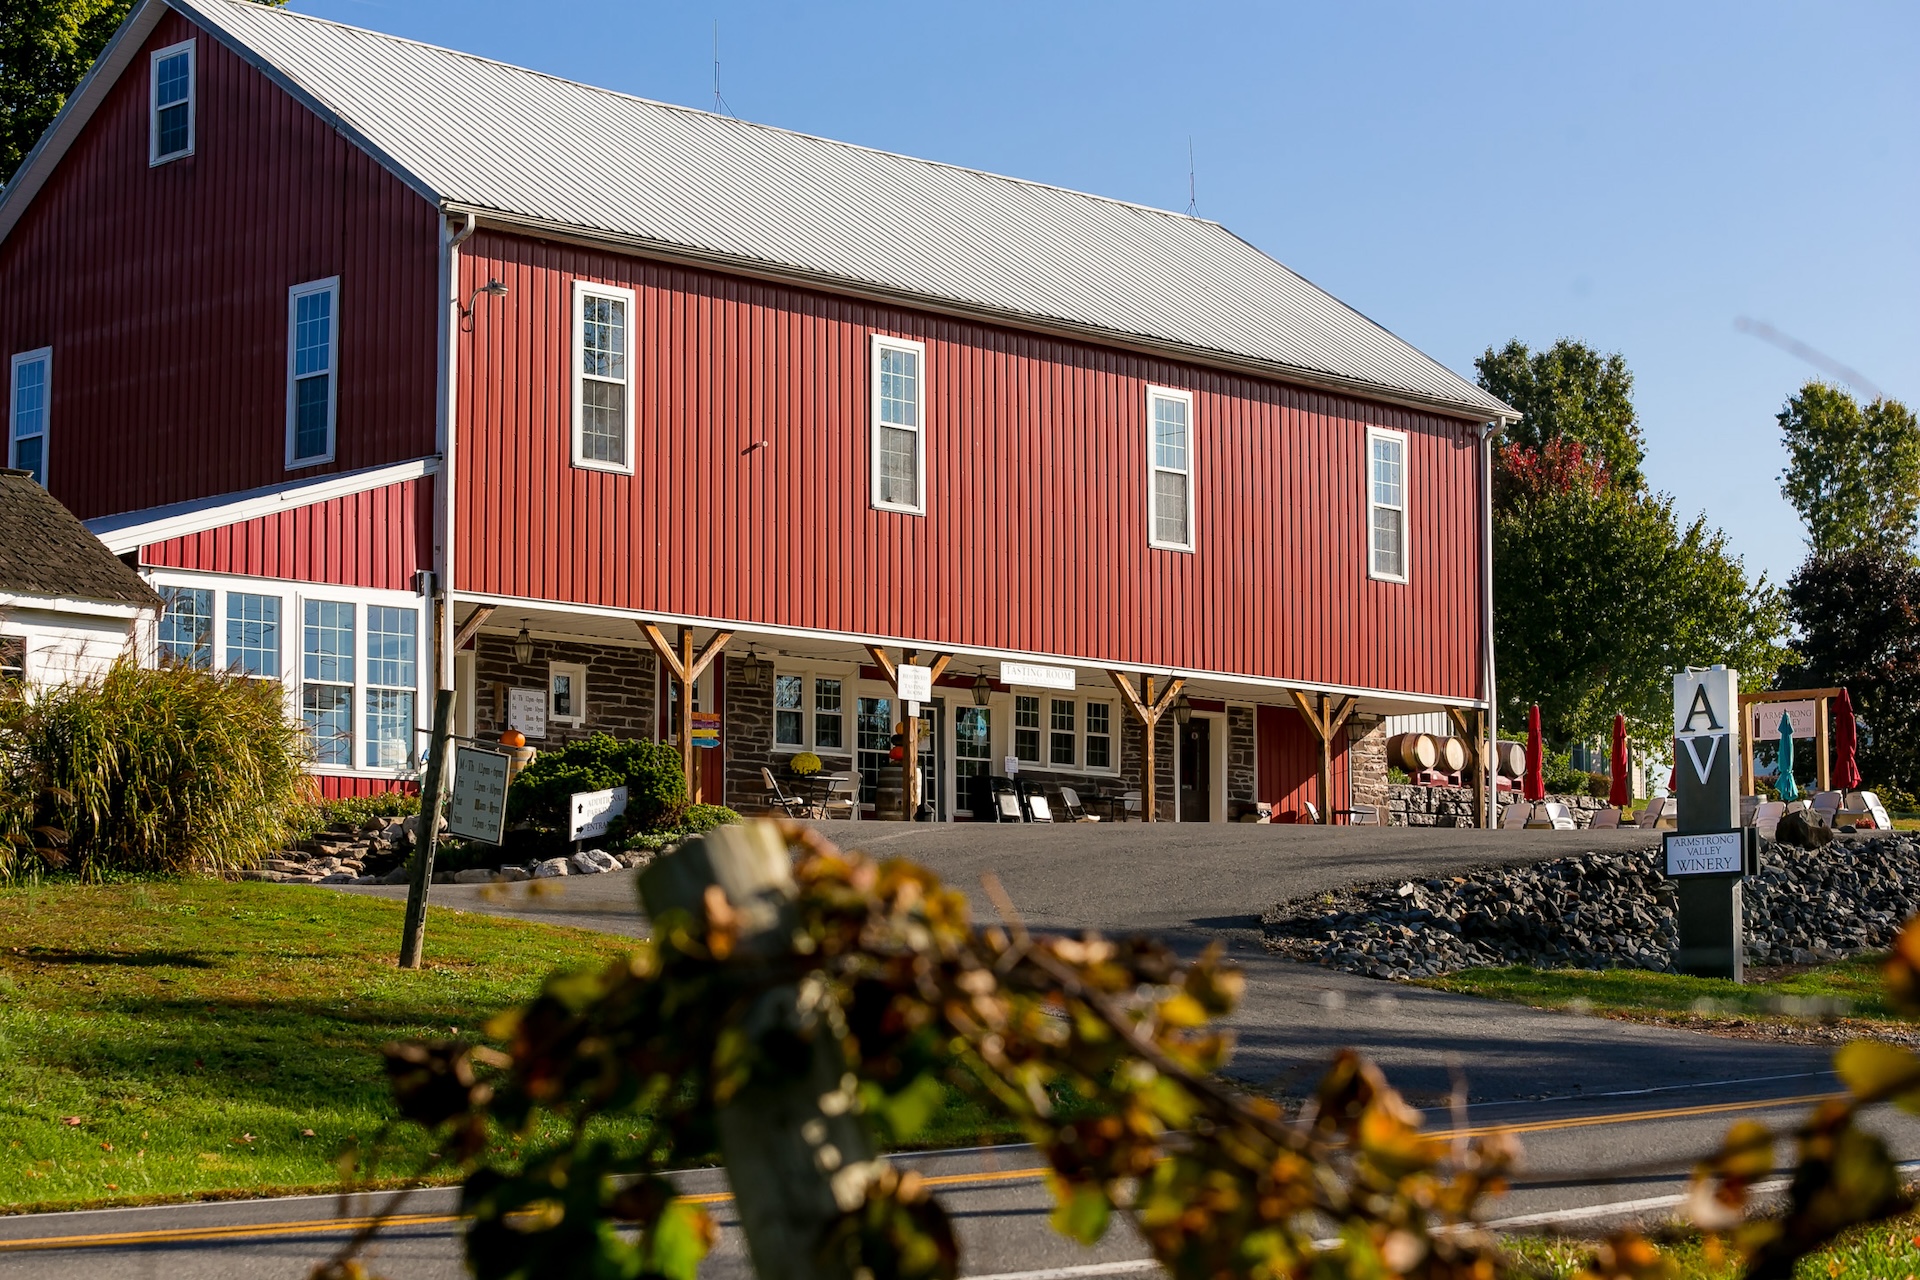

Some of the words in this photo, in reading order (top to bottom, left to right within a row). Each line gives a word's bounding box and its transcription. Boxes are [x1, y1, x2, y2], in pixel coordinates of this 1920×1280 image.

[1006, 665, 1043, 678] TASTING
[1046, 669, 1071, 681] ROOM
[1679, 682, 1724, 733] A
[1763, 709, 1812, 720] ARMRONG
[1773, 718, 1801, 727] VEY
[1679, 734, 1724, 785] V
[468, 759, 475, 772] Th
[478, 762, 490, 776] 12pm
[493, 766, 503, 779] 6pm
[474, 780, 486, 793] 12pm
[489, 783, 501, 797] 10pm
[587, 793, 625, 808] ADDITIONAL
[586, 806, 614, 818] PARKING
[454, 811, 462, 824] Sun
[472, 817, 484, 830] 12pm
[487, 820, 497, 833] 5pm
[1673, 835, 1734, 847] ARMSTRONG
[1686, 846, 1722, 856] VALLEY
[1676, 857, 1733, 872] WINERY
